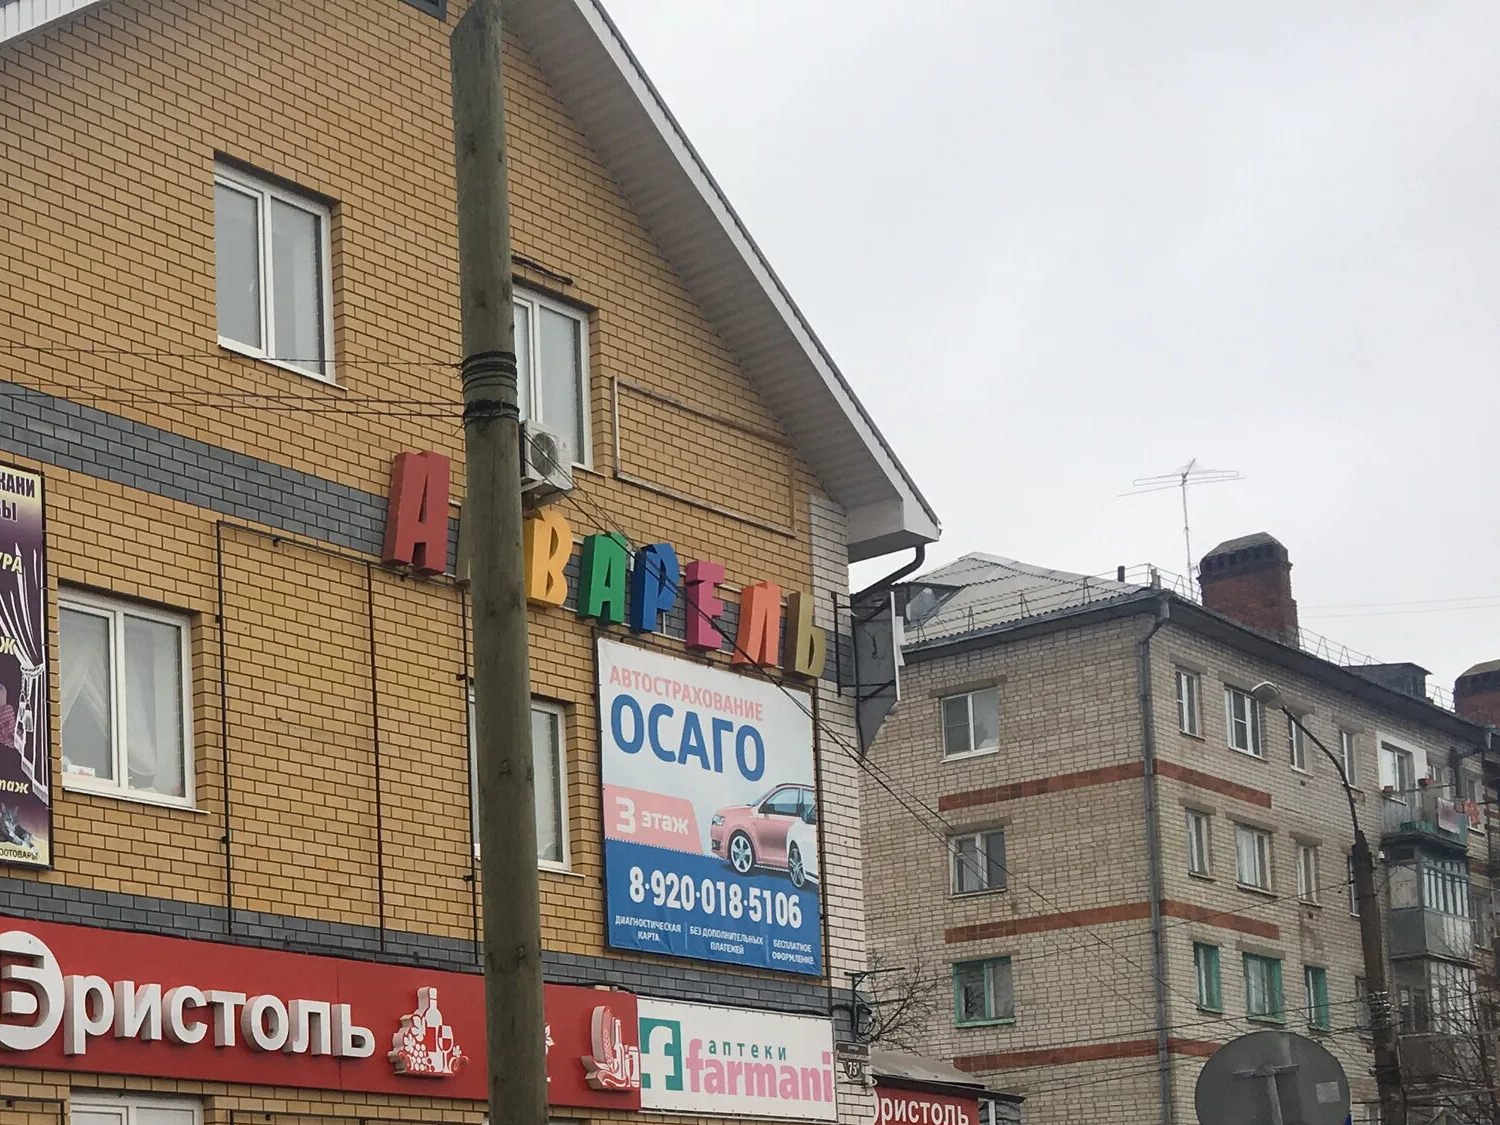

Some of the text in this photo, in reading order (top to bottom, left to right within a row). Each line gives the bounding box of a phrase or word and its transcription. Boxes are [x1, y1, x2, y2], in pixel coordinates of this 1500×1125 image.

[382, 451, 826, 680] АВАРЕЛЬ
[609, 665, 764, 722] АВТОСТРАХОВАНИЕ
[610, 693, 765, 782] ОСАГО
[616, 797, 689, 836] 3 этаж
[615, 915, 682, 933] ДИАГНОСТИЧЕСКАЯ
[689, 925, 764, 945] БЕЗ ДОПОЛНИТЕЛЬНЫХ
[637, 931, 660, 942] КАРТА
[773, 939, 812, 953] БЕСПЛАТНОЕ
[710, 942, 745, 955] ПЛАТЕЖЕЙ
[771, 952, 814, 965] ОФОРМЛЕНИЕ
[707, 1037, 787, 1061] аптеки
[686, 1039, 834, 1103] farmani
